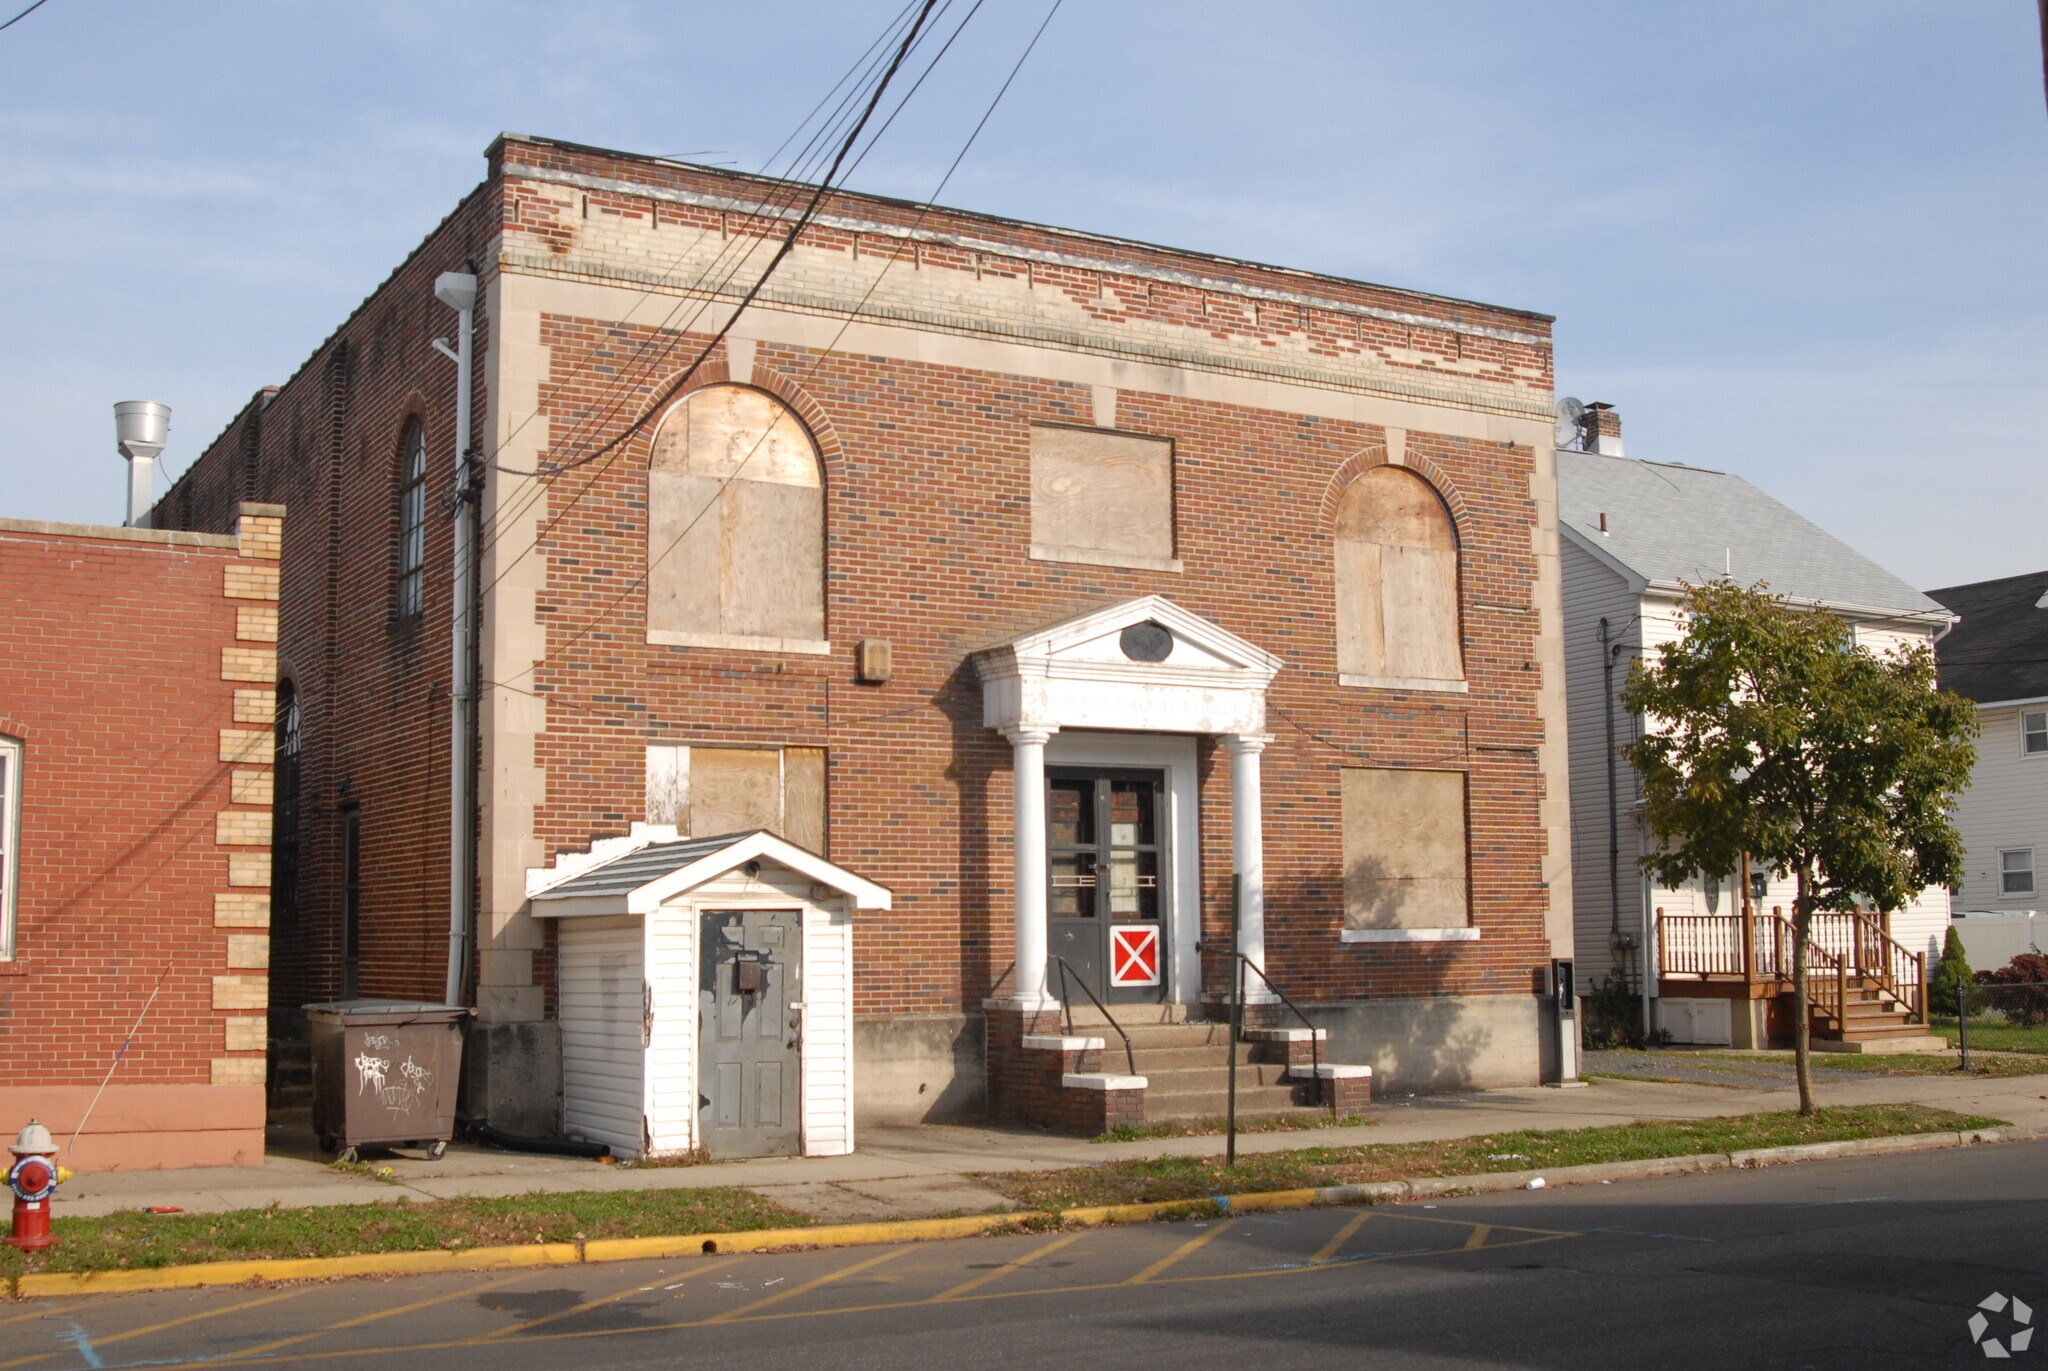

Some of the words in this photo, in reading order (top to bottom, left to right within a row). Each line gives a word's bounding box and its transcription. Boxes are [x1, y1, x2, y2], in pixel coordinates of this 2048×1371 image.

[1051, 695, 1089, 708] SONS
[1116, 697, 1153, 712] ITALY
[1160, 699, 1242, 716] AUDITORIUM
